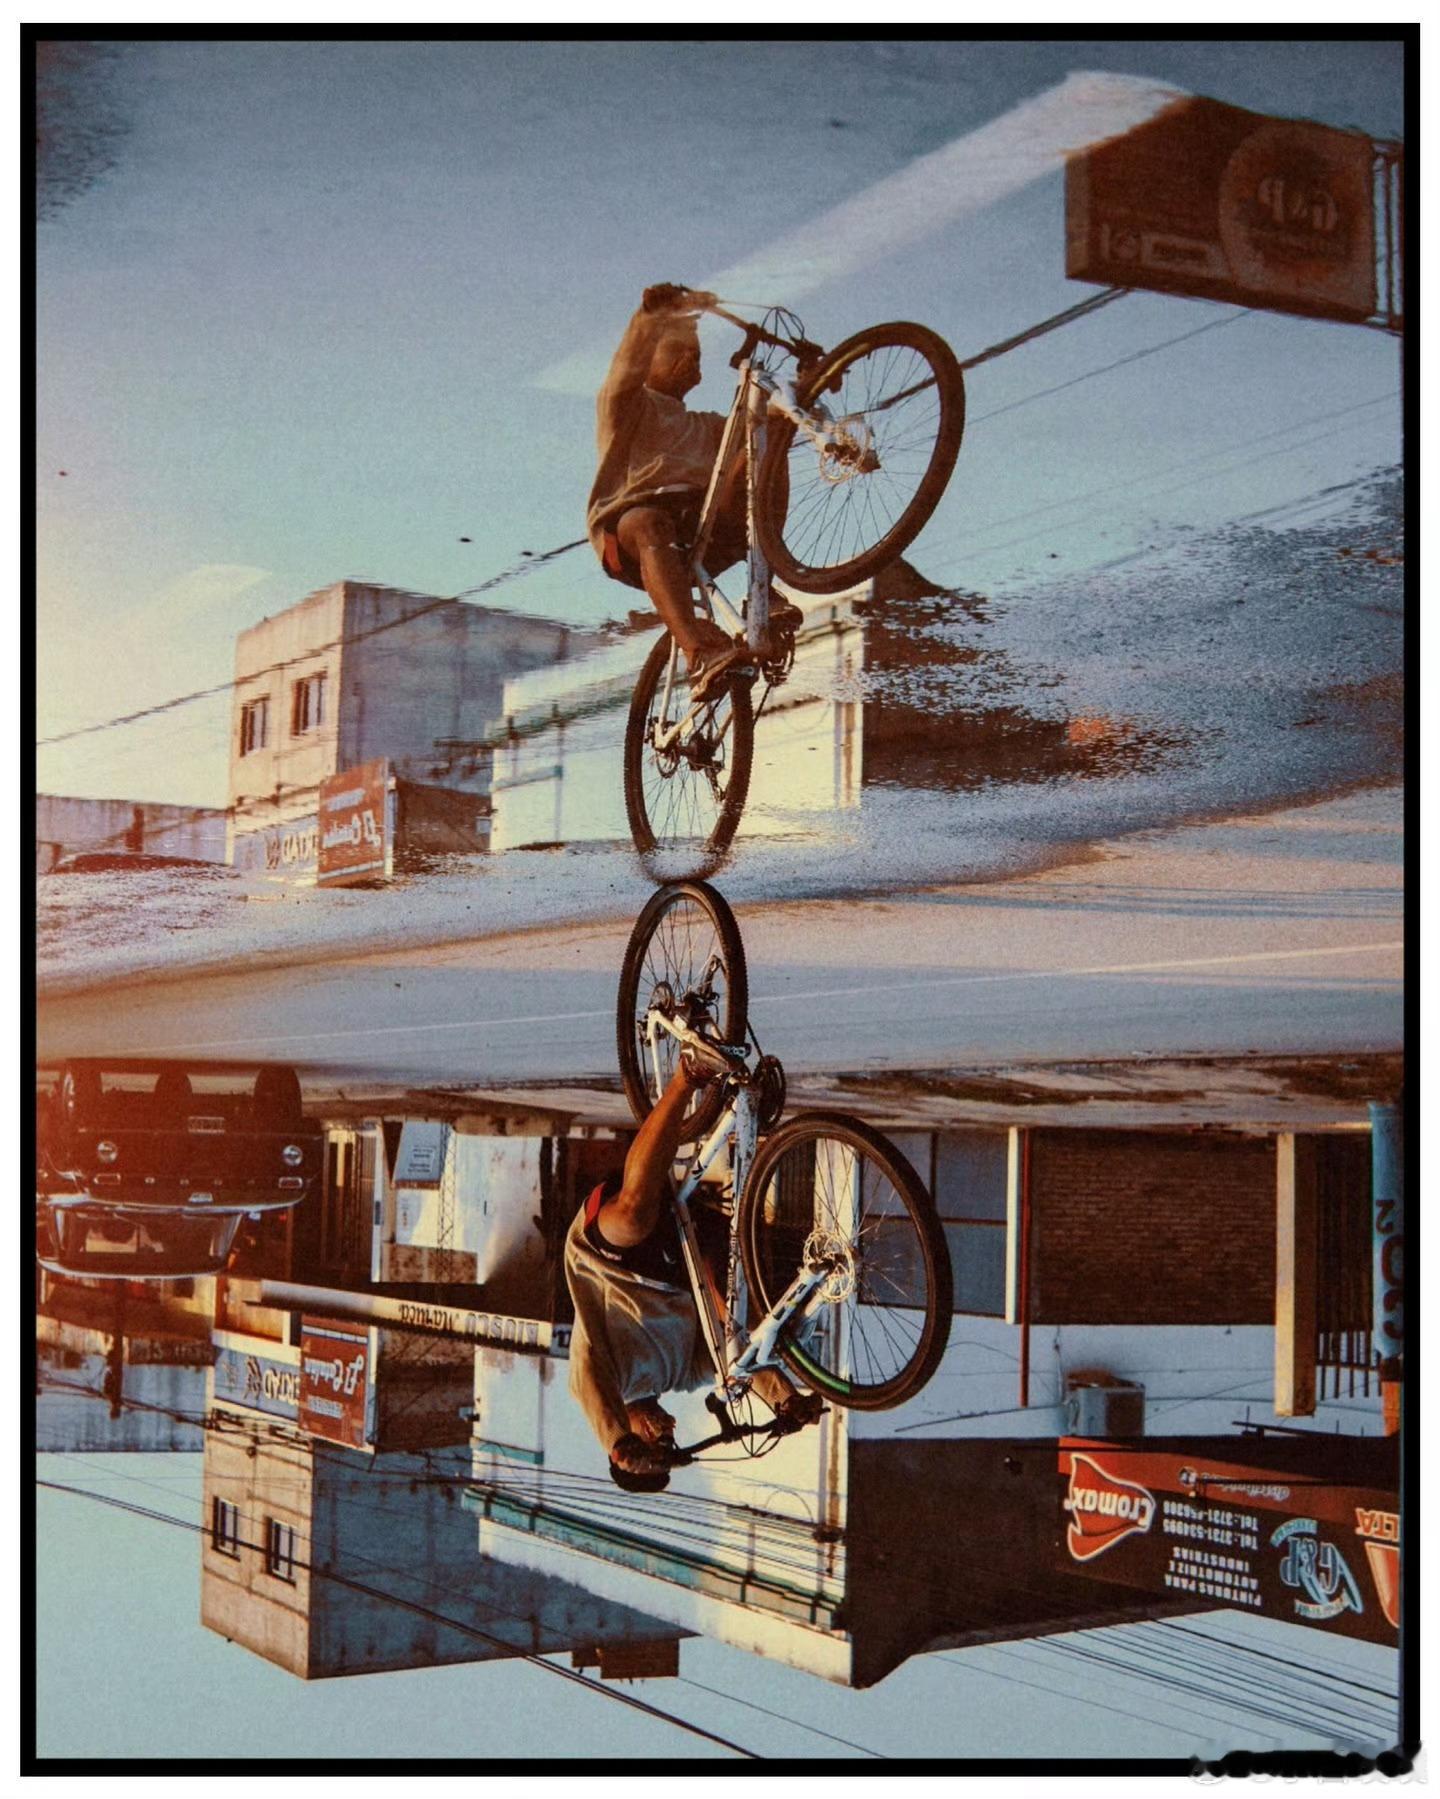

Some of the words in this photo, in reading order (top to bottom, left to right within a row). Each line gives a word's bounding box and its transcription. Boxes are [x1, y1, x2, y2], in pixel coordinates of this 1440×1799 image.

[1177, 1563, 1258, 1590] AUTOMOTRIZ
[1279, 1536, 1339, 1594] G&P
[1164, 1573, 1196, 1592] PARA
[1198, 1582, 1262, 1607] PINTURAS
